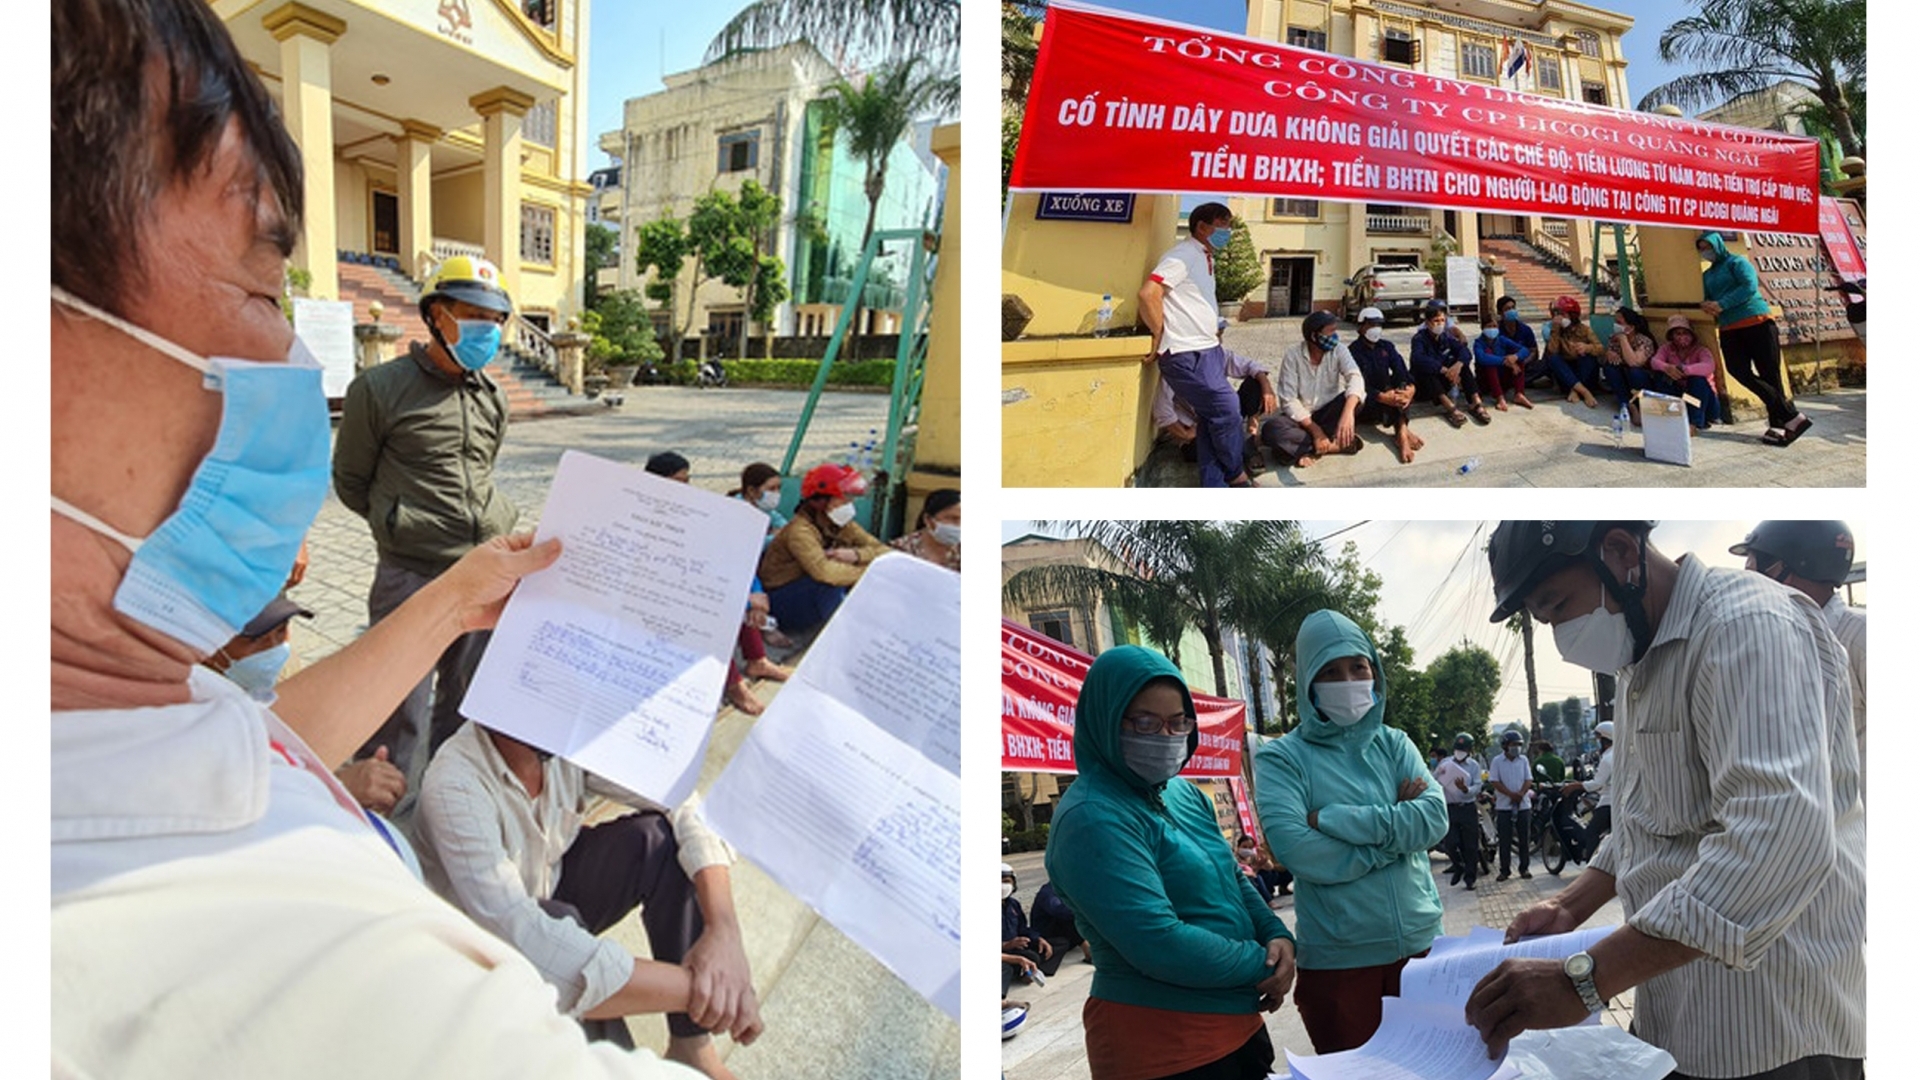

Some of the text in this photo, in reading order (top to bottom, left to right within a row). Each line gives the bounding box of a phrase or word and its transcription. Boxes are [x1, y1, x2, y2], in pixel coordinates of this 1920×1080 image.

[1143, 35, 1282, 68] TỔNG
[1299, 58, 1416, 88] CÔNG
[1427, 78, 1470, 96] TY
[1058, 91, 1100, 126] CỐ
[1105, 96, 1166, 129] TÌNH
[1171, 102, 1223, 133] DÂY
[1228, 110, 1278, 138] DƯA
[1285, 115, 1361, 146] KHÔNG
[1367, 120, 1408, 150] GIẢI
[1413, 129, 1470, 158] QUYẾT
[1476, 136, 1510, 163] CÁC
[1513, 141, 1545, 167] CHẾ
[1609, 155, 1651, 180] LƯƠNG
[1264, 80, 1389, 110] CÔNG
[1402, 98, 1449, 118] TY
[1461, 106, 1506, 124] CP
[1517, 115, 1619, 142] LICOGI
[1627, 132, 1708, 158] QUẢNG
[1104, 199, 1124, 213] XE
[1190, 144, 1247, 179] TIỀN
[1253, 155, 1325, 188] BHXH;
[1332, 155, 1380, 189] TIỀN
[1386, 166, 1438, 193] BHTN
[1444, 172, 1480, 197] CHO
[1485, 175, 1536, 202] NGƯỜI
[1541, 181, 1568, 205] LAO
[1571, 182, 1609, 211] ĐỘNG
[1611, 189, 1632, 215] TẠI
[1634, 189, 1666, 214] CÔNG
[1668, 196, 1682, 215] TY
[1683, 197, 1698, 217] CP
[1699, 199, 1730, 220] LICOGI
[1057, 700, 1076, 728] GIẢ
[1007, 733, 1045, 762] BHXH;
